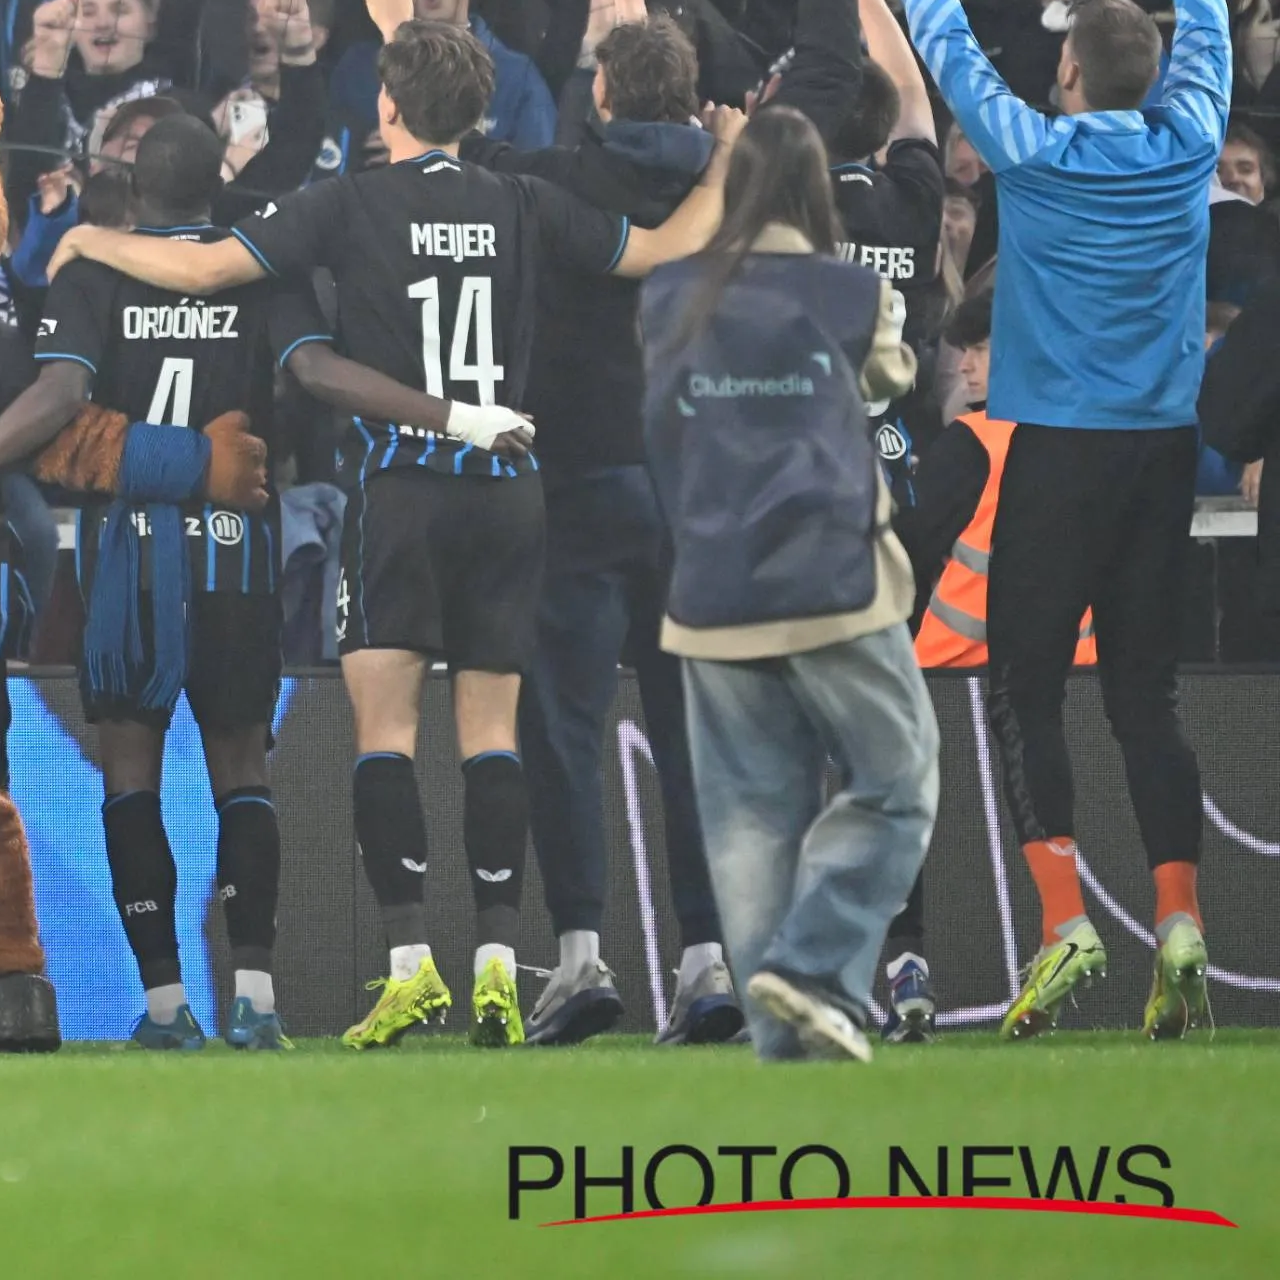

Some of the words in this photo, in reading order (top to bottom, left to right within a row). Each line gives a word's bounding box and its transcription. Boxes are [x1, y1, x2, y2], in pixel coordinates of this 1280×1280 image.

[410, 222, 497, 262] MEIJER
[123, 297, 239, 340] ORDÓÑEZ
[407, 276, 505, 408] 14
[690, 373, 815, 398] Clubmedia
[124, 899, 159, 917] FCB
